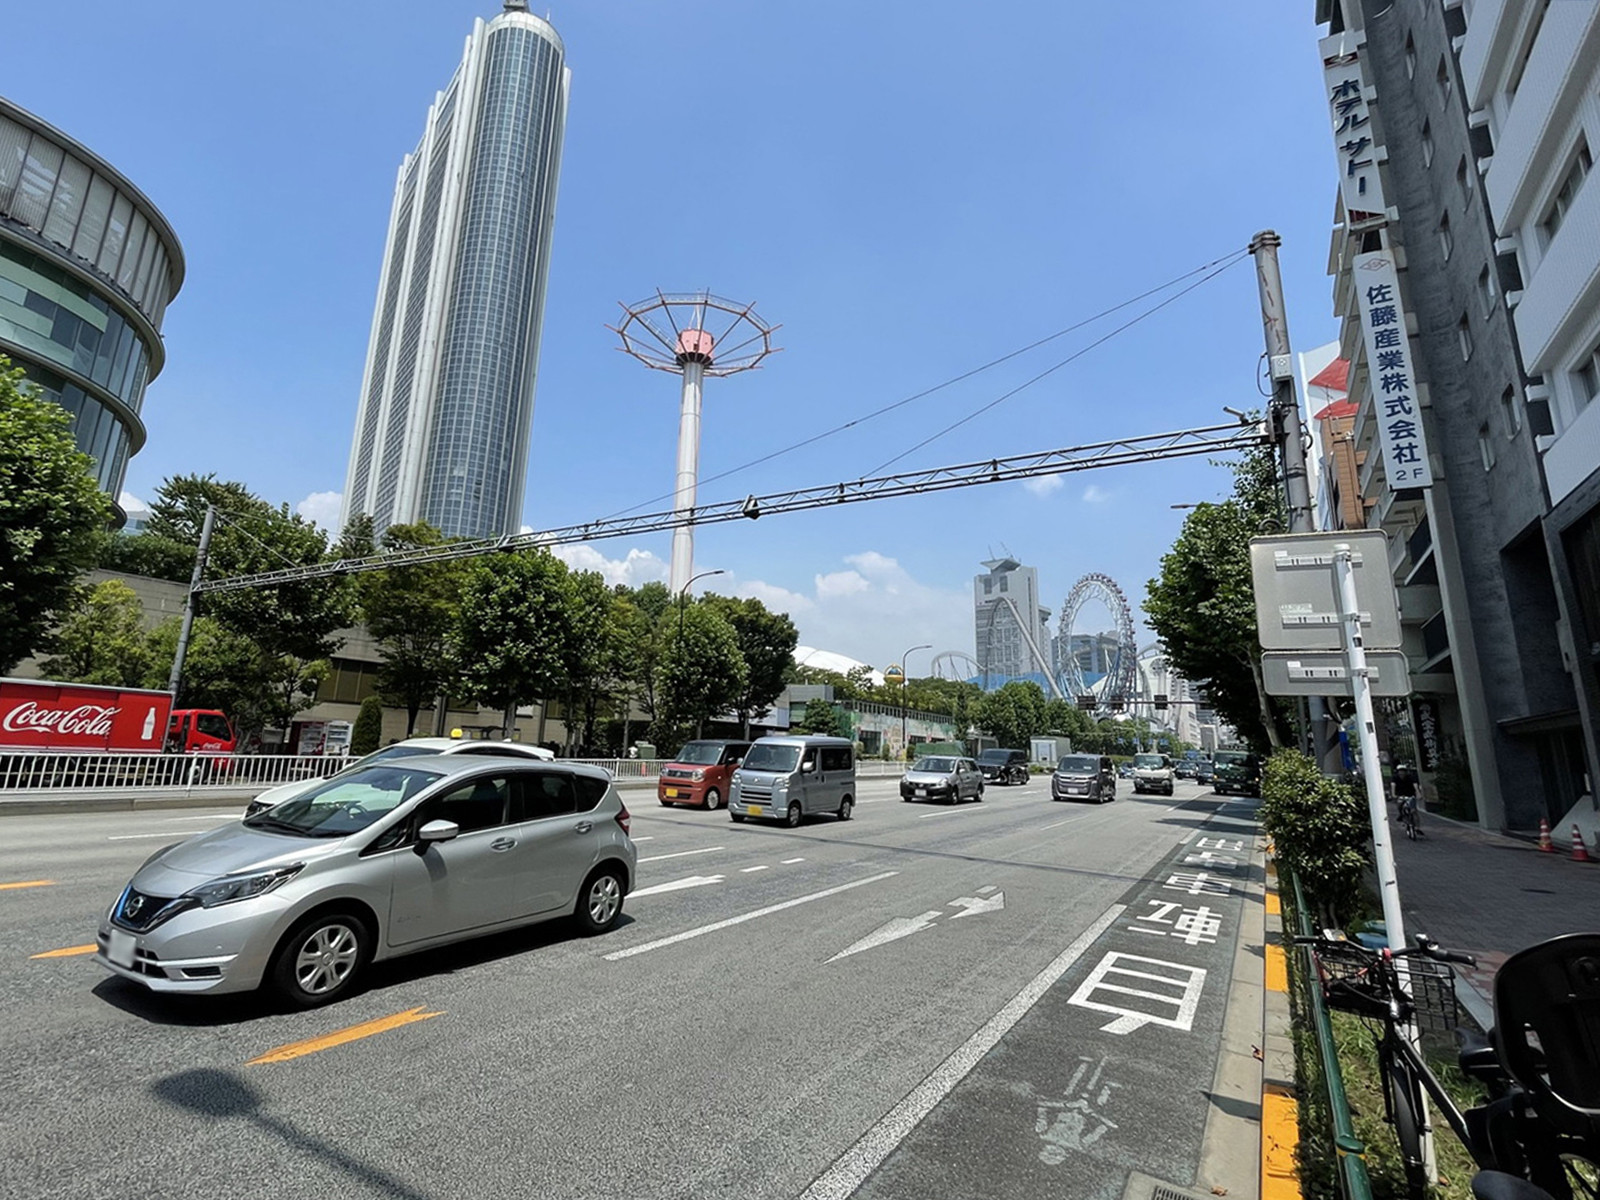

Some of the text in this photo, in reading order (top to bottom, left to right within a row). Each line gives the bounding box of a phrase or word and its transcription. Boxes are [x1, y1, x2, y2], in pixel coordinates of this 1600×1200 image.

[1330, 79, 1372, 195] ホテルサトー
[1366, 283, 1421, 465] 佐藤産業株式会社
[1395, 467, 1424, 482] 2F
[2, 701, 122, 735] Coca-Cola
